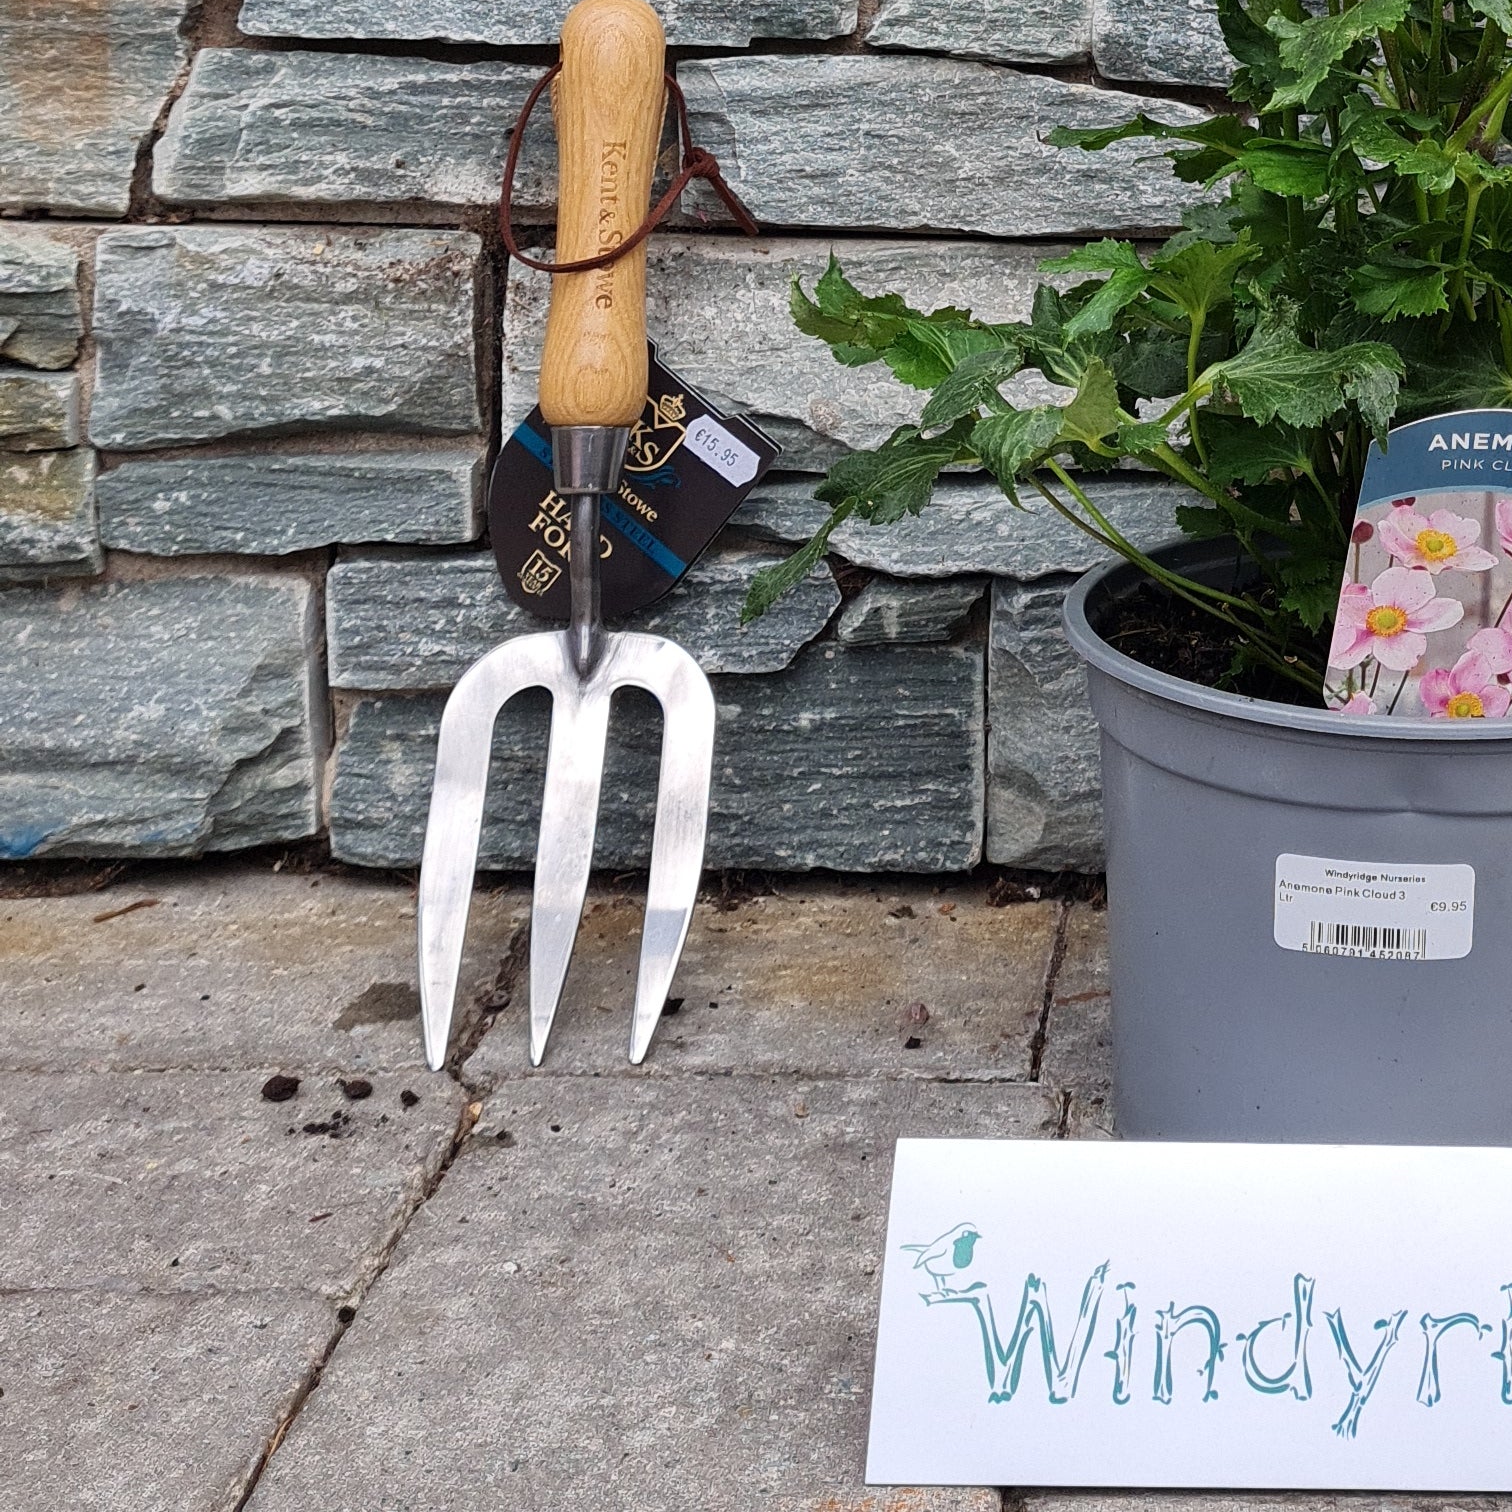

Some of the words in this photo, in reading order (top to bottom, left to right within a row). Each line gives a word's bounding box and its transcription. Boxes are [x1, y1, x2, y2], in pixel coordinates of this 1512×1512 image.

[601, 139, 627, 205] Kent
[599, 208, 616, 226] &
[694, 428, 739, 467] €15.95
[1441, 458, 1485, 471] PINK
[539, 489, 613, 559] HAD
[529, 558, 552, 582] 15
[1325, 868, 1378, 884] Windyridge
[1380, 873, 1427, 884] Nurseries
[1279, 879, 1333, 895] Anemone
[1335, 886, 1361, 899] Pink
[1362, 888, 1396, 900] Cloud
[1398, 890, 1407, 901] 3
[1279, 892, 1294, 903] Ltr
[1430, 900, 1468, 912] €9.95
[1302, 942, 1309, 952] 5
